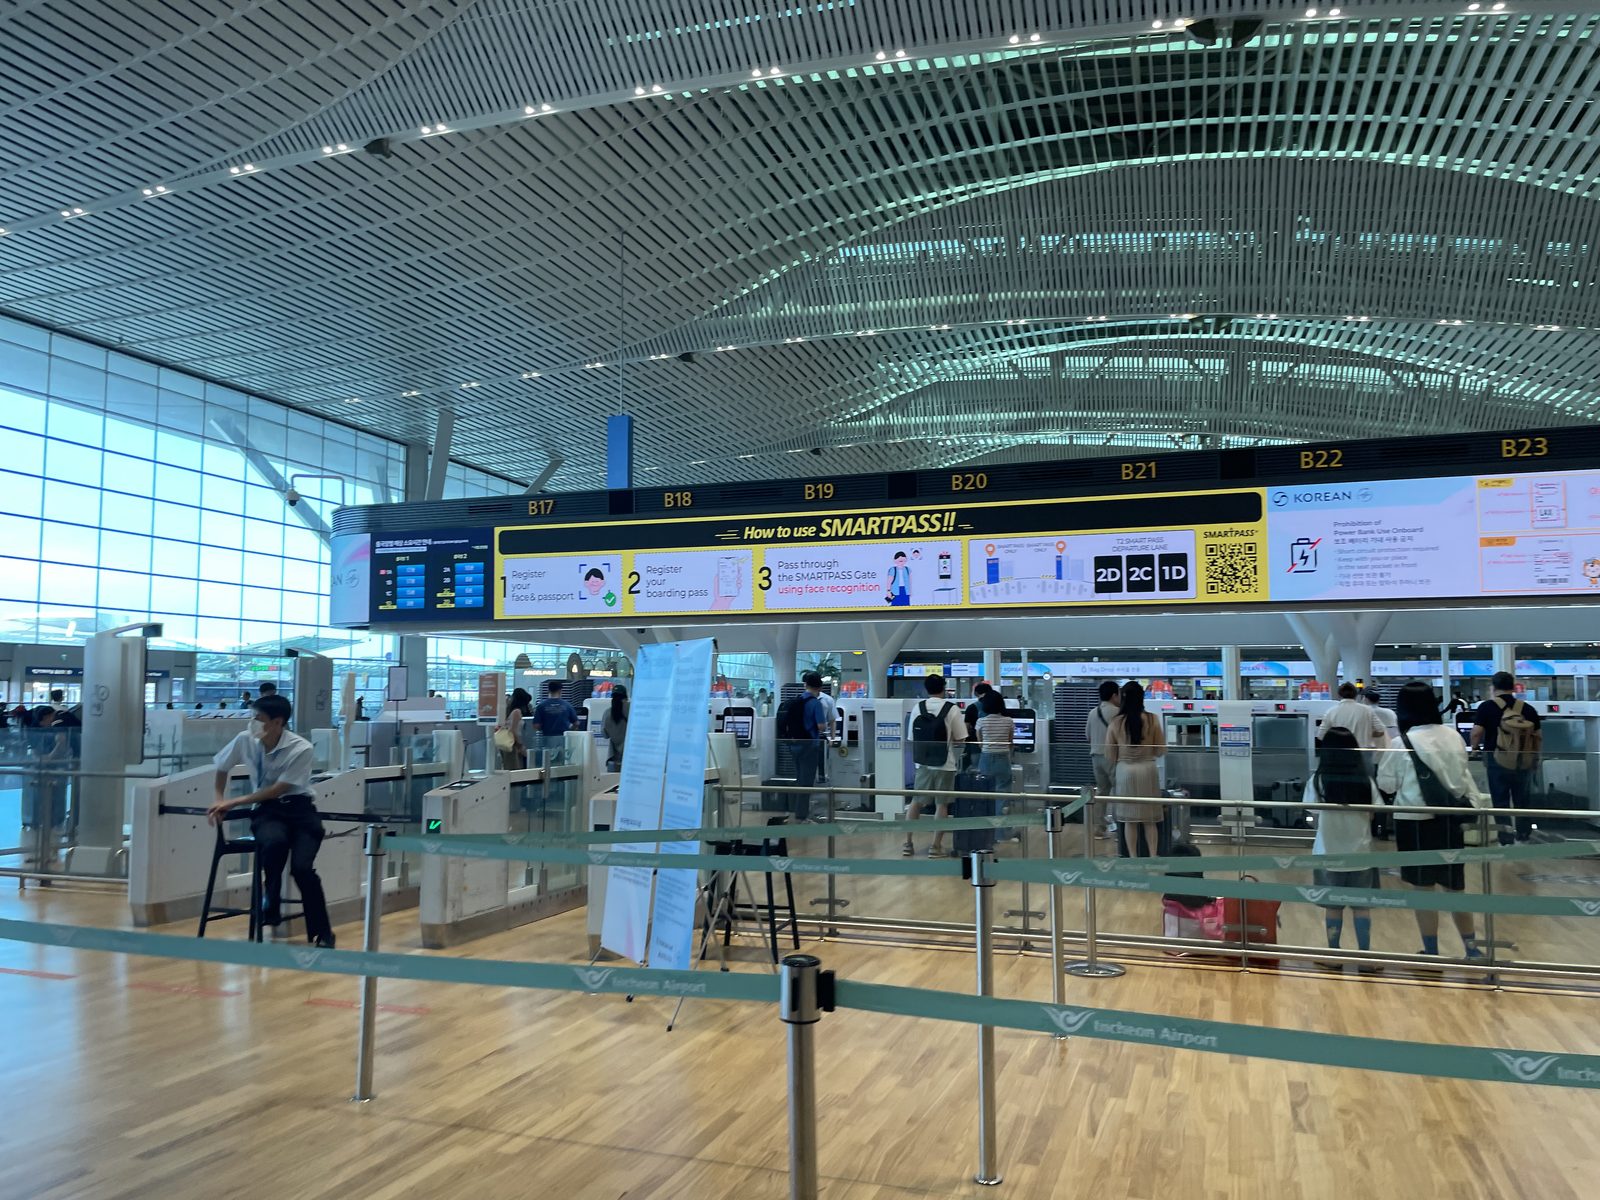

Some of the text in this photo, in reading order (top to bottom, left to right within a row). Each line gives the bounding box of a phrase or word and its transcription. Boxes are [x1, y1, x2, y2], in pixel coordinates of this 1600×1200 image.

[1501, 437, 1549, 458] B23
[1300, 449, 1343, 469] B22
[1121, 462, 1158, 481] B21
[951, 473, 987, 491] B20
[804, 483, 834, 501] B19
[1293, 491, 1351, 503] KOREAN
[528, 500, 554, 515] B17
[664, 492, 692, 508] B18
[743, 511, 956, 540] How to use SMARTPASS!!
[1203, 529, 1255, 538] SMARTPASS
[646, 565, 683, 575] Register
[778, 559, 839, 570] Pass through
[511, 570, 546, 579] Register
[758, 566, 772, 591] 3
[778, 570, 877, 582] the SMARTPASS Gate
[1096, 567, 1121, 582] 2D
[1129, 567, 1152, 581] 2C
[1162, 565, 1186, 580] 1D
[500, 576, 507, 598] 1
[511, 583, 530, 592] your
[628, 571, 641, 595] 2
[646, 579, 666, 588] your
[778, 583, 881, 595] using face recognition
[538, 592, 574, 602] passport
[646, 589, 709, 600] boarding pass
[663, 979, 706, 994] Airport
[1093, 1020, 1218, 1047] Incheon Airport
